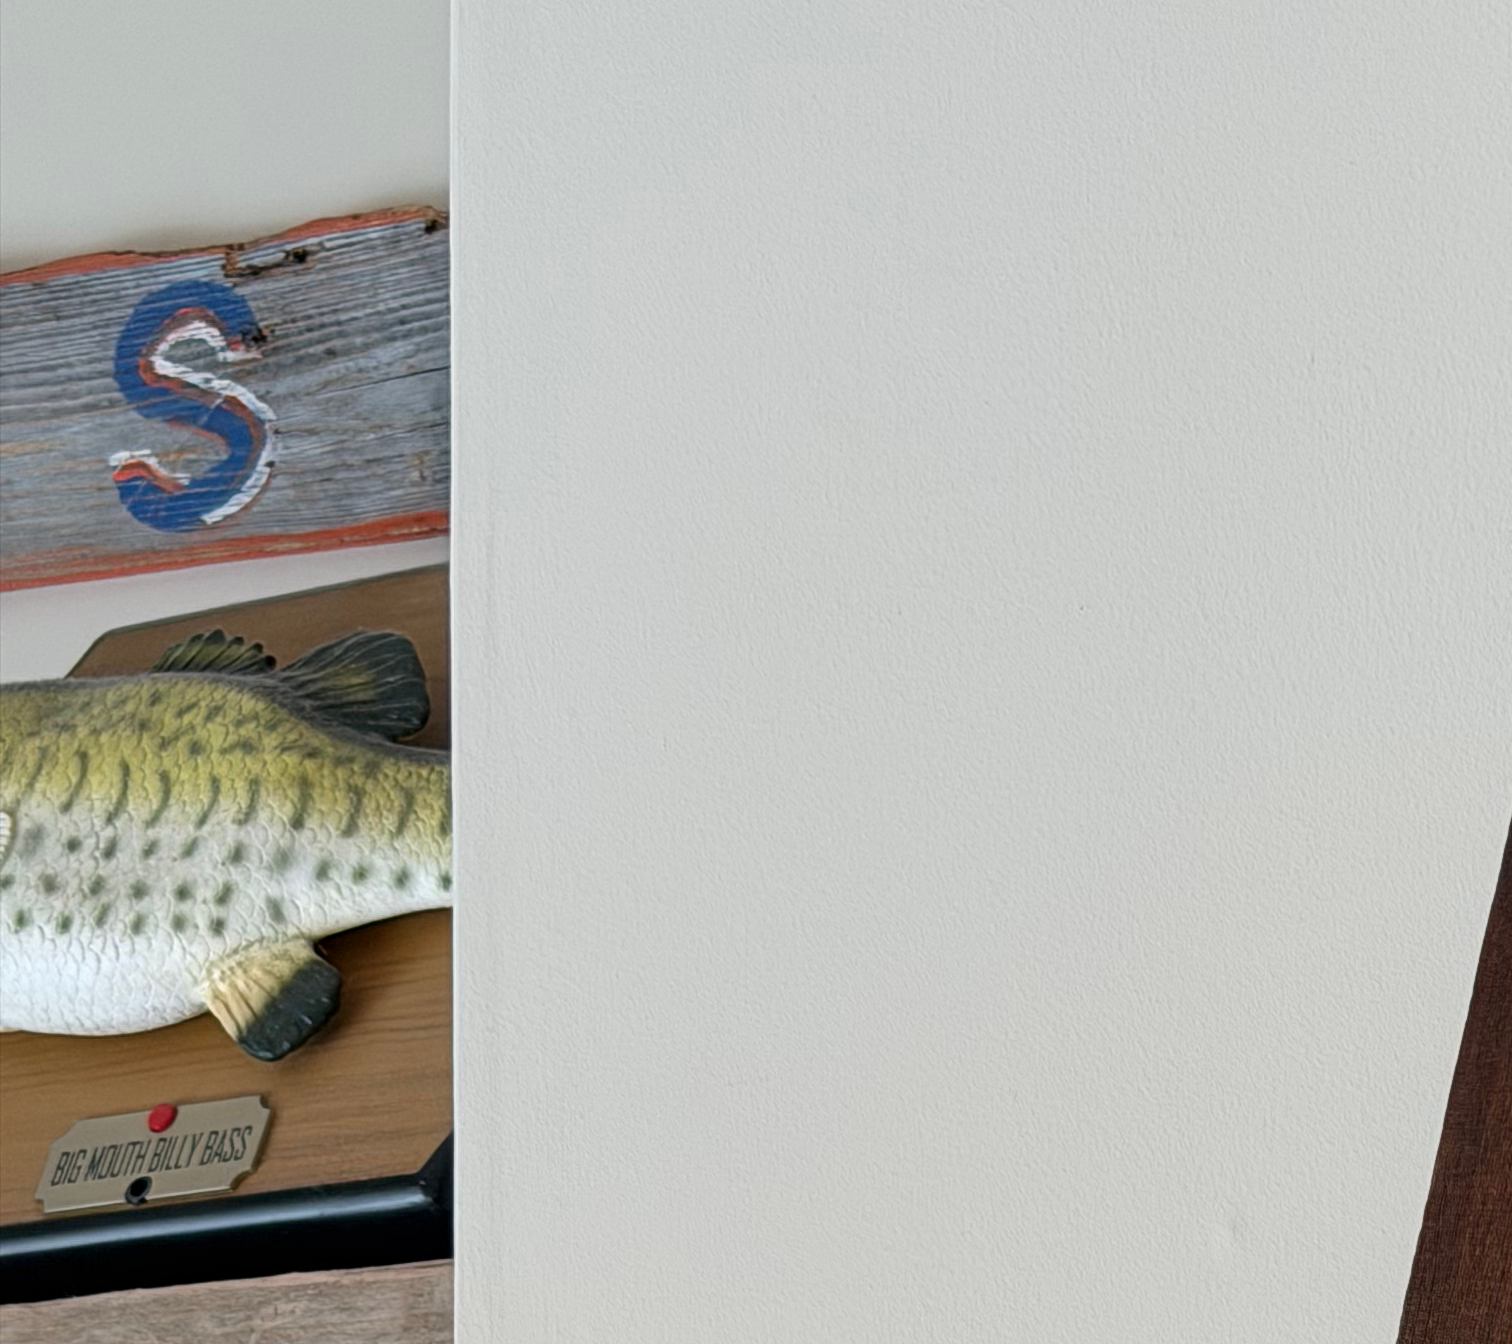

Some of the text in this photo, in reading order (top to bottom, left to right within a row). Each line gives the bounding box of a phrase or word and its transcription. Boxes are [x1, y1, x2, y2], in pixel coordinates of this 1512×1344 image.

[109, 279, 277, 534] S
[51, 1125, 253, 1186] BIG MOUTH BILLY BASS
